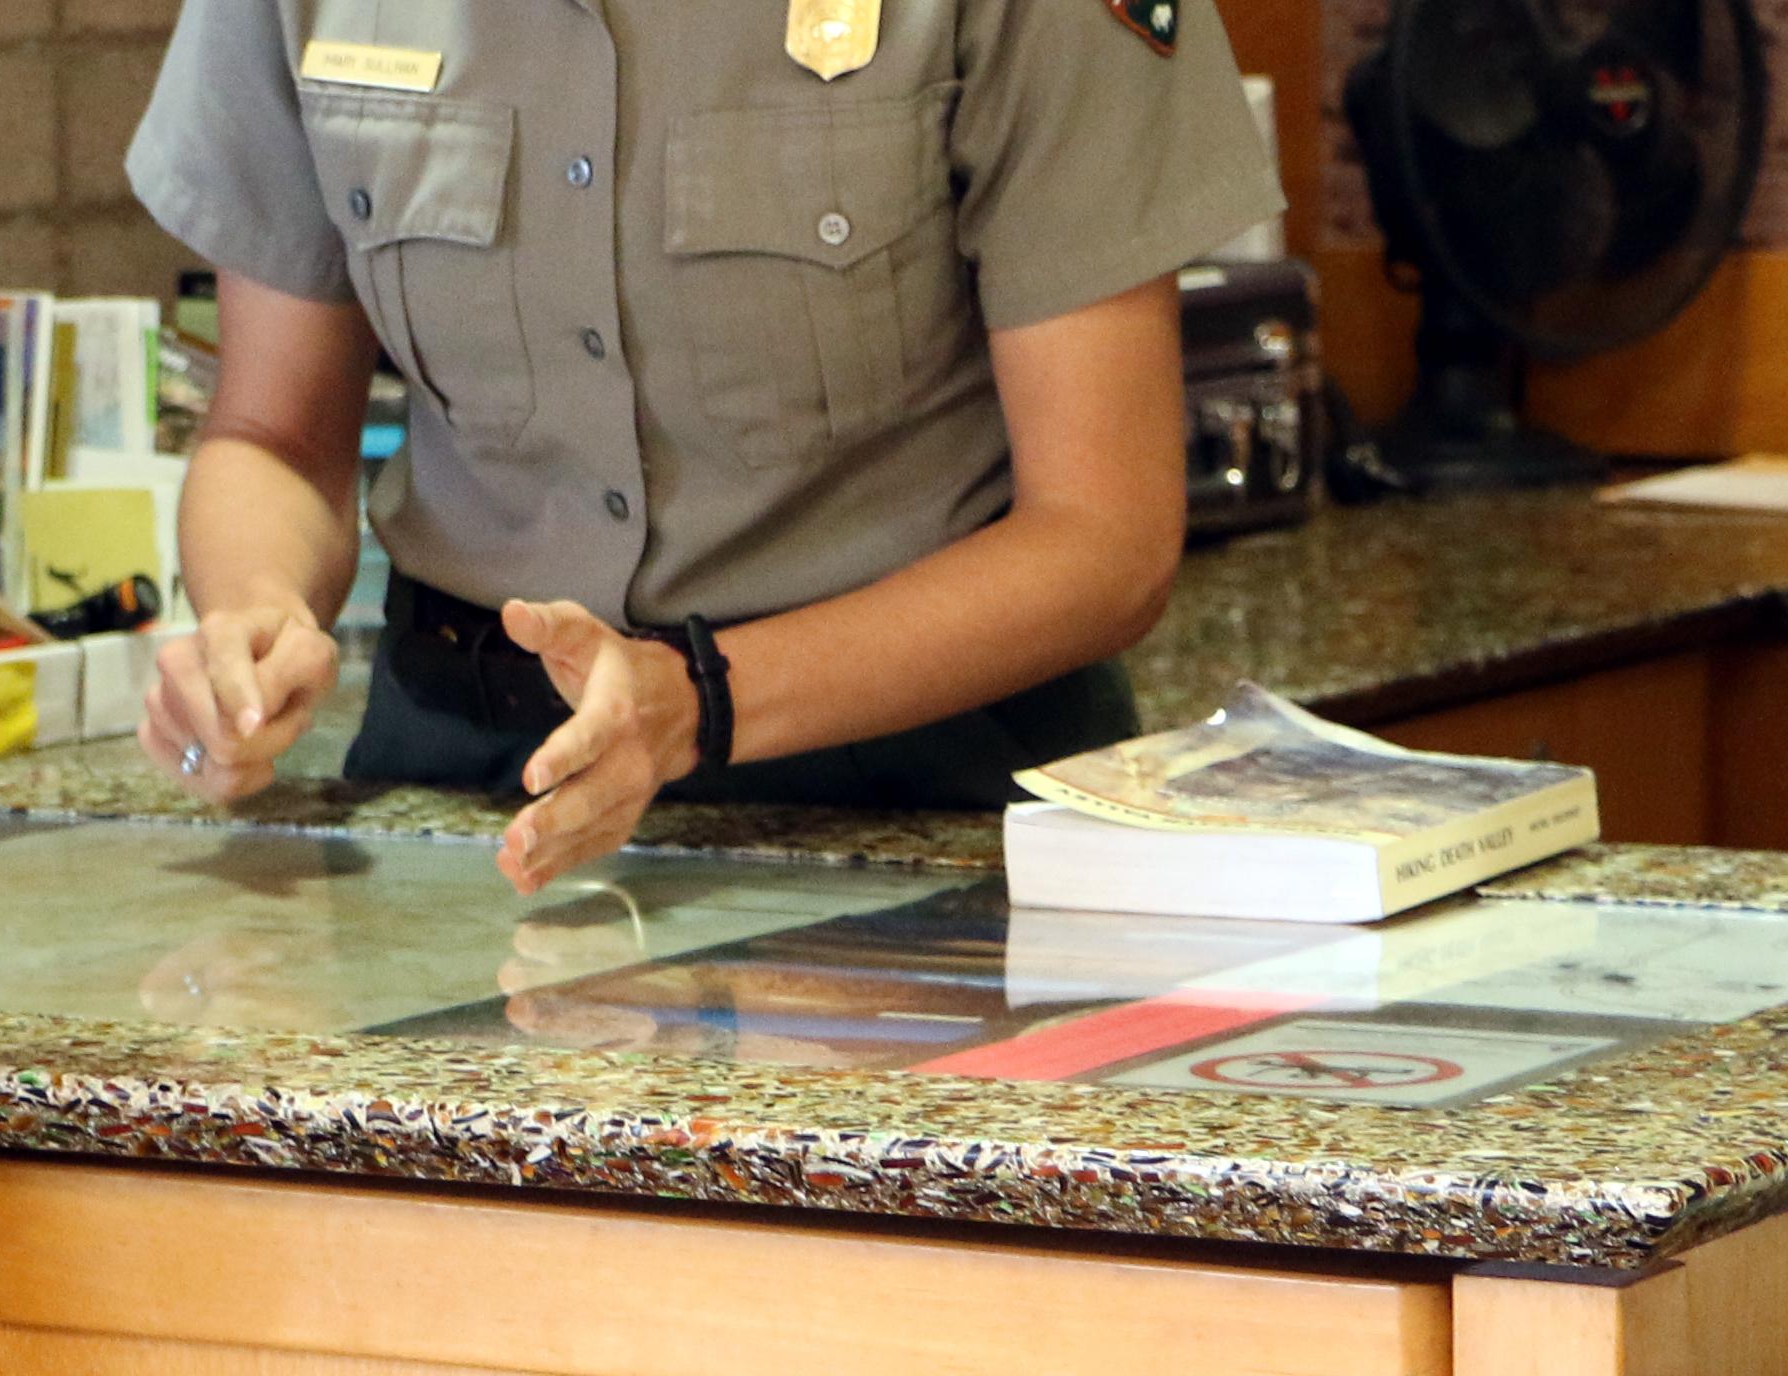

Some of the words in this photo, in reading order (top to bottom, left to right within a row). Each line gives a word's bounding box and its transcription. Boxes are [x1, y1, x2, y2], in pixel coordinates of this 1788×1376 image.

[1395, 852, 1437, 883] HIKING
[1439, 838, 1476, 868] DEATH
[1476, 826, 1513, 853] VALLEY
